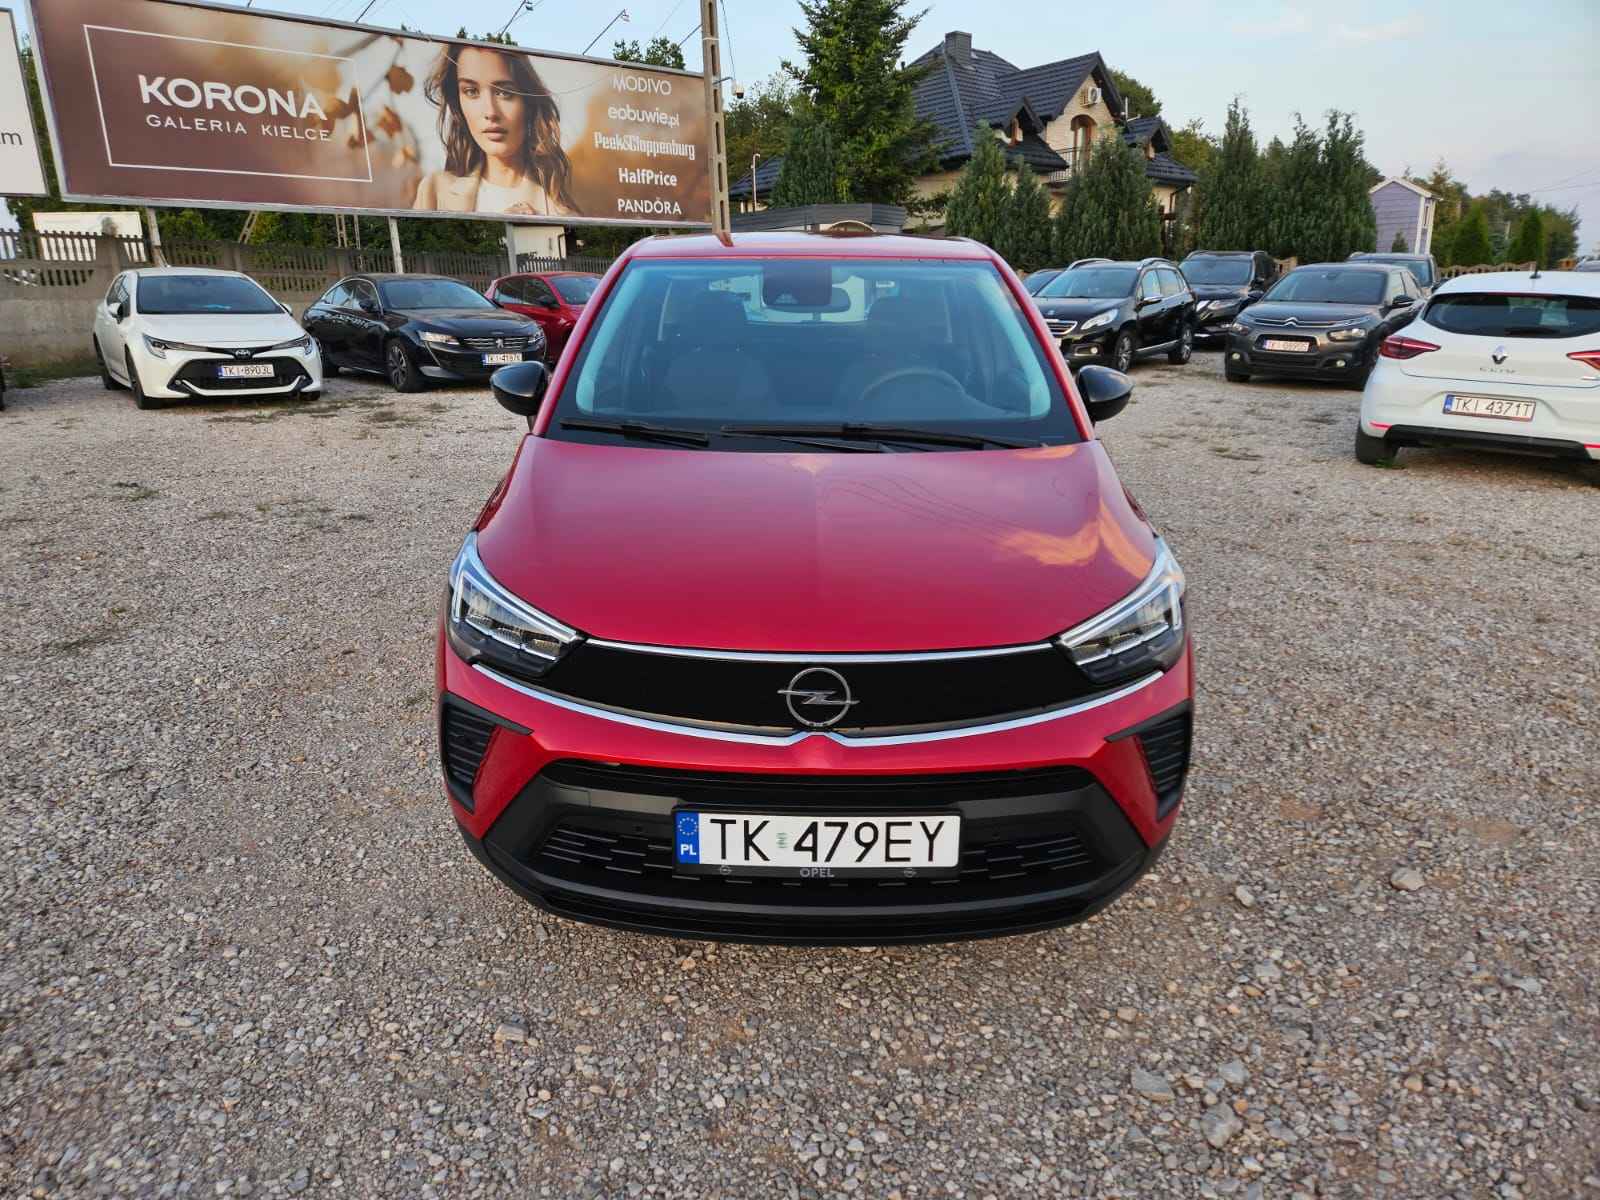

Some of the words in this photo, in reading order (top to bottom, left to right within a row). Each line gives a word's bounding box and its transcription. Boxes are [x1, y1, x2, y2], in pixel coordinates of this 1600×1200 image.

[612, 75, 672, 96] MODIVO
[138, 74, 328, 121] KORONA
[607, 104, 680, 127] eobuwie.pl
[146, 114, 248, 135] GALERIA
[261, 123, 332, 142] KIELCE
[618, 168, 678, 187] HalfPrice
[617, 197, 682, 215] PANDORA
[1455, 397, 1478, 411] TKI
[1486, 401, 1533, 417] 4371T
[680, 843, 697, 856] PL
[709, 818, 771, 862] TK
[793, 821, 946, 863] 479EY
[799, 867, 835, 878] OPEL
